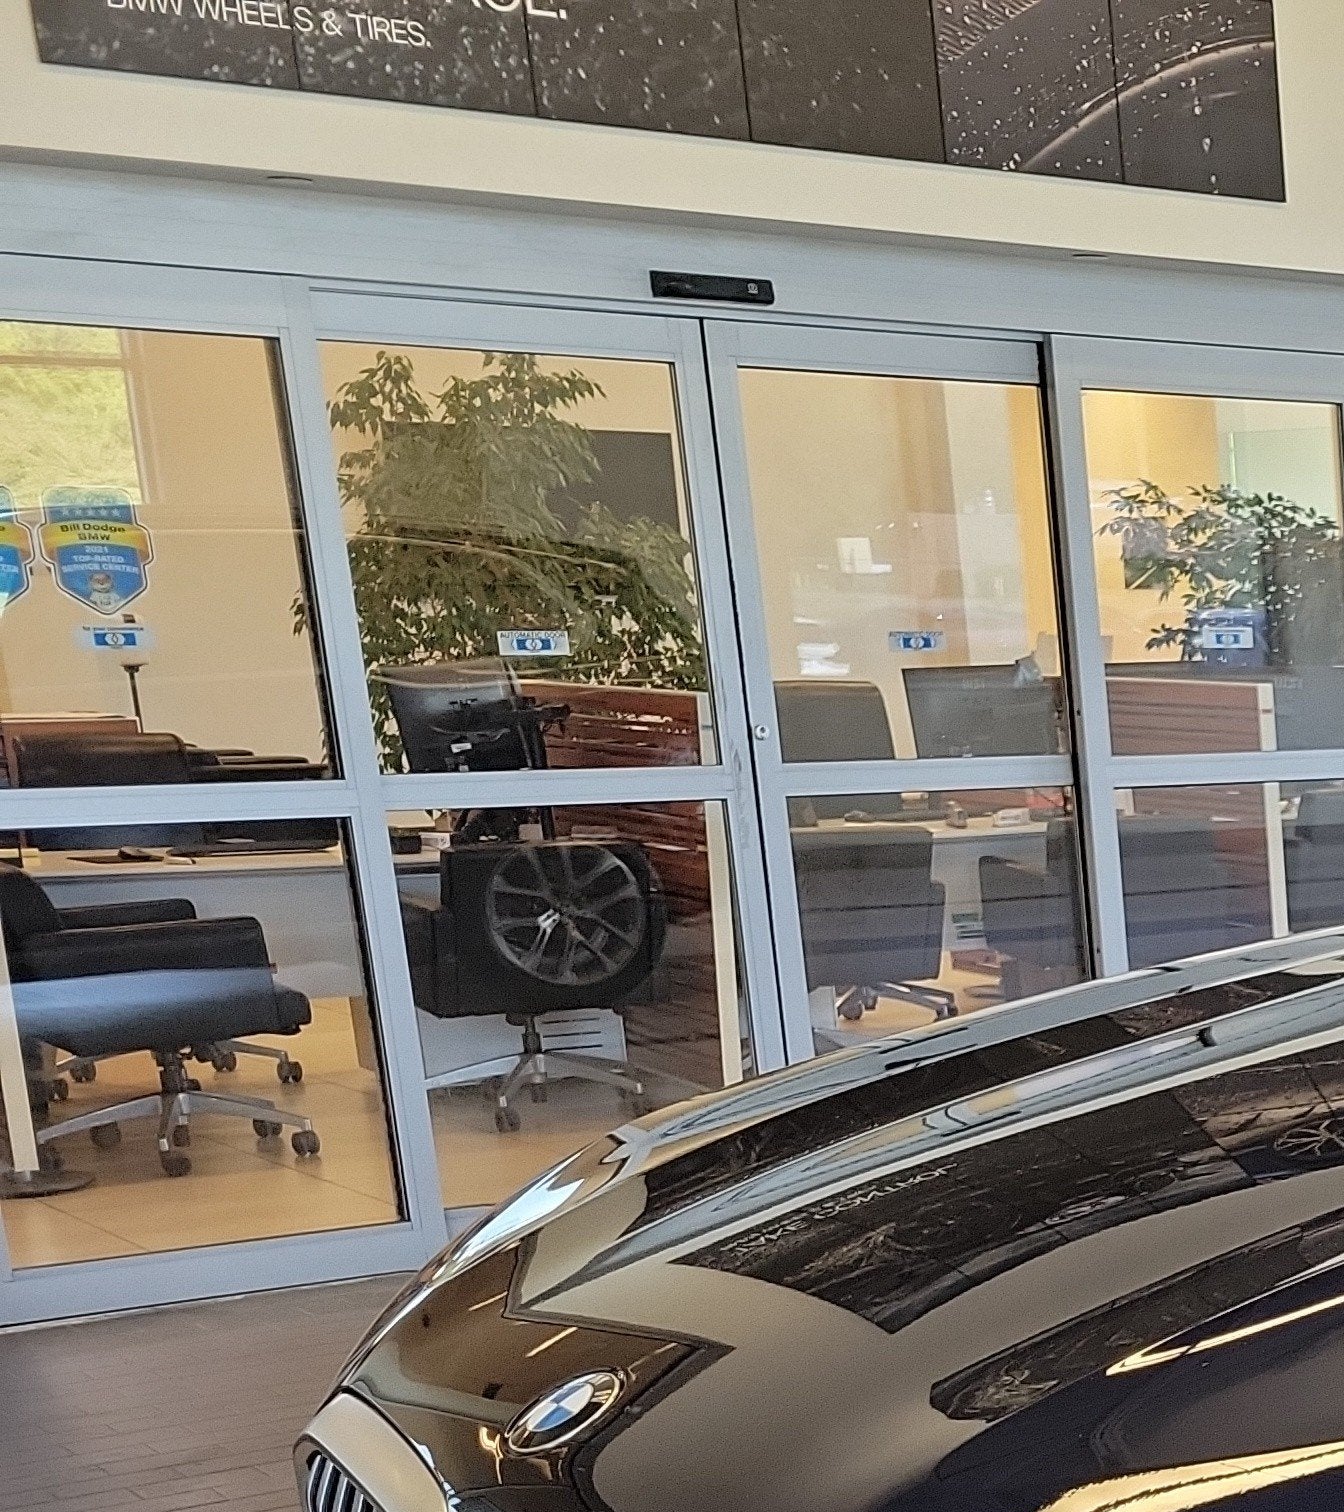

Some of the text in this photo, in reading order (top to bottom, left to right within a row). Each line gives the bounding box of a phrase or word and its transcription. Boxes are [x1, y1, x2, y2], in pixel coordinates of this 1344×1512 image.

[194, 0, 314, 32] WHEELS
[322, 9, 343, 37] &
[347, 12, 433, 48] TIRES.
[60, 523, 126, 533] Bill Dodge
[78, 533, 110, 541] BMW
